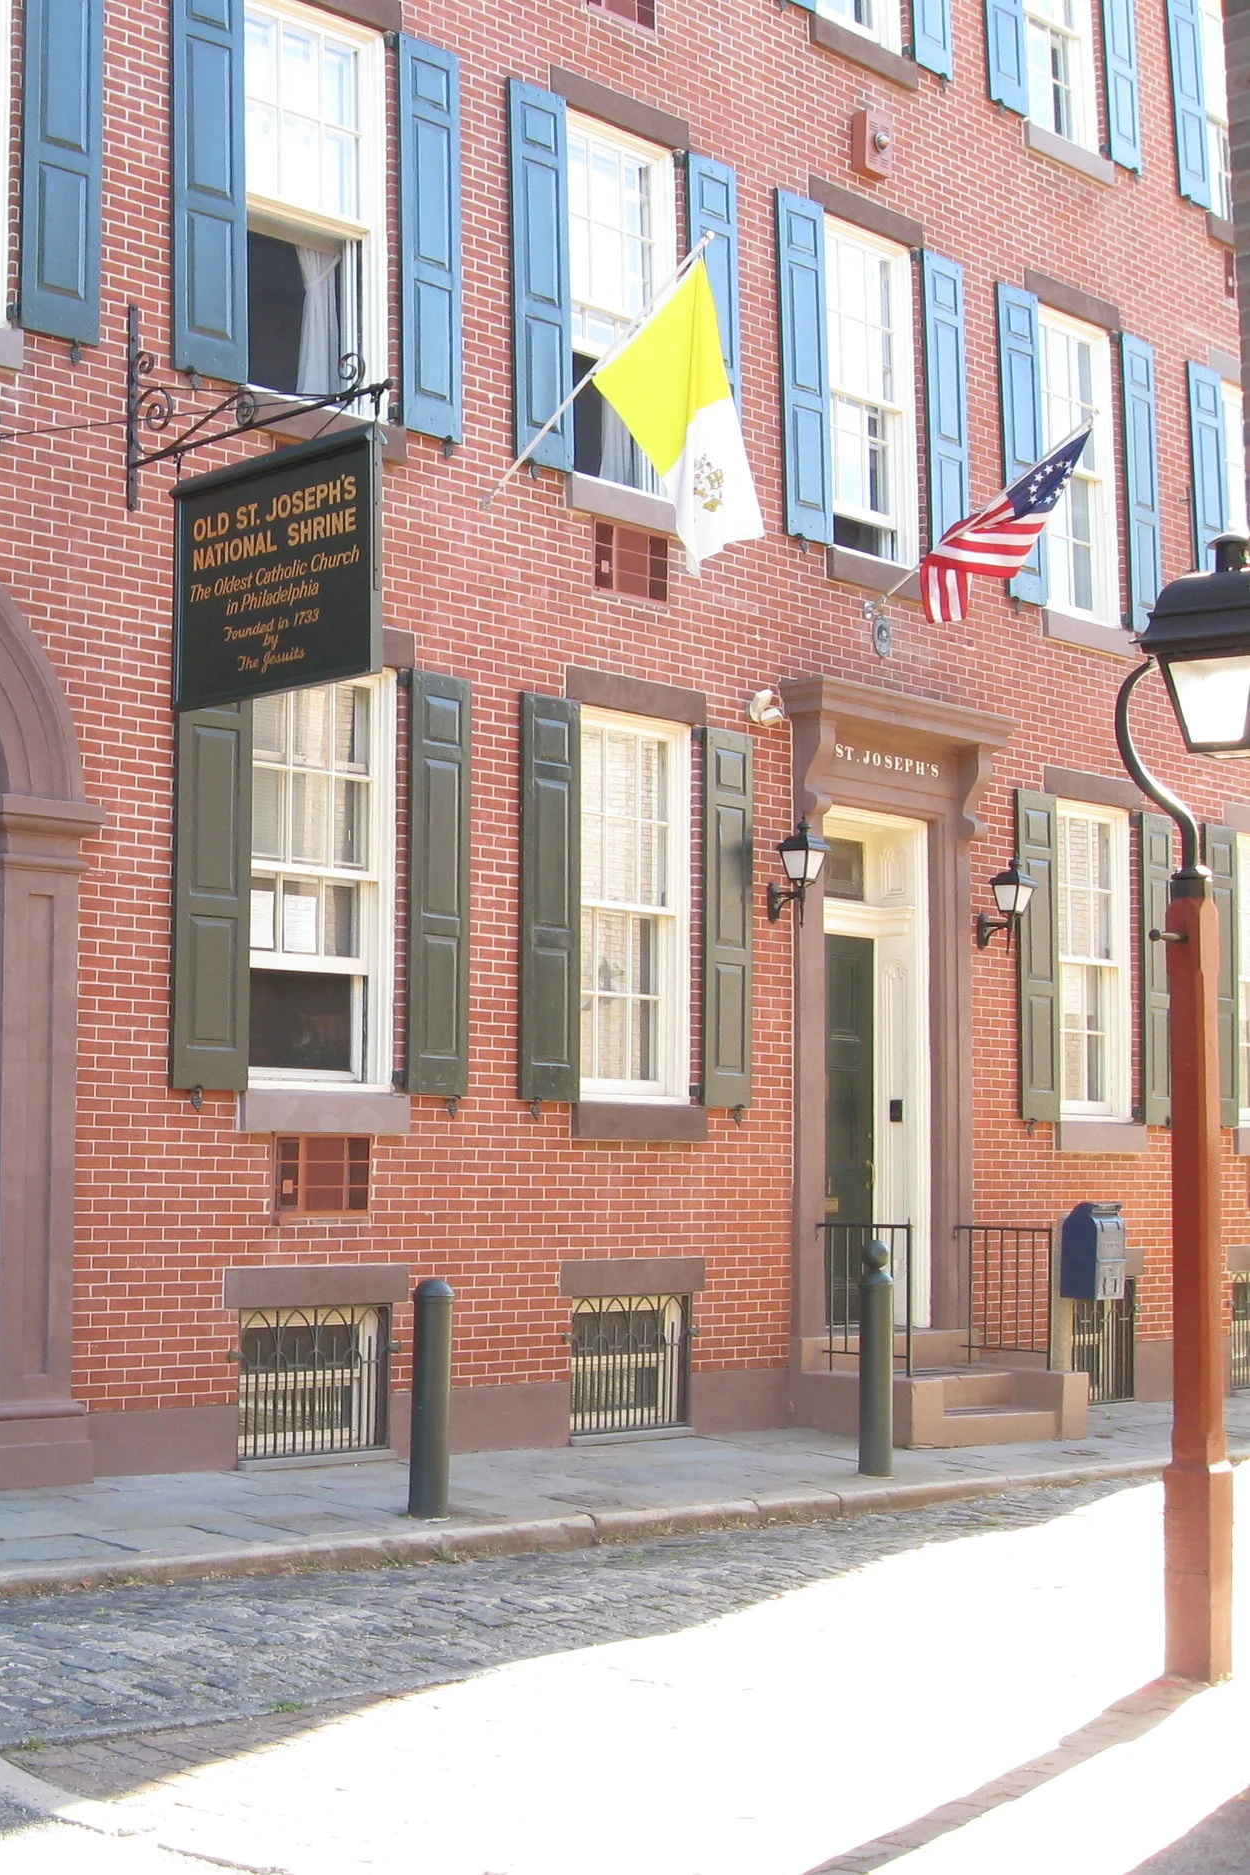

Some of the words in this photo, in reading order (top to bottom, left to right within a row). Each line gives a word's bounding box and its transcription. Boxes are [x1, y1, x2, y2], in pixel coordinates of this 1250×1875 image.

[193, 512, 230, 541] OLD
[236, 502, 261, 530] ST.
[265, 474, 357, 522] JOSEPH'S
[192, 530, 278, 572] NATIONAL
[287, 506, 357, 546] SHRINE
[189, 583, 212, 603] The
[214, 572, 253, 596] Oldest
[255, 559, 308, 587] Catholic
[310, 544, 360, 573] Church
[225, 599, 239, 616] in
[240, 579, 320, 613] Philadelphia
[222, 617, 275, 642] Founded
[277, 616, 290, 631] in
[293, 607, 320, 627] 1733
[262, 632, 279, 651] by
[236, 655, 259, 672] The
[261, 646, 306, 674] Jesuits
[835, 743, 860, 763] ST.
[862, 750, 940, 778] JOSEPH'S
